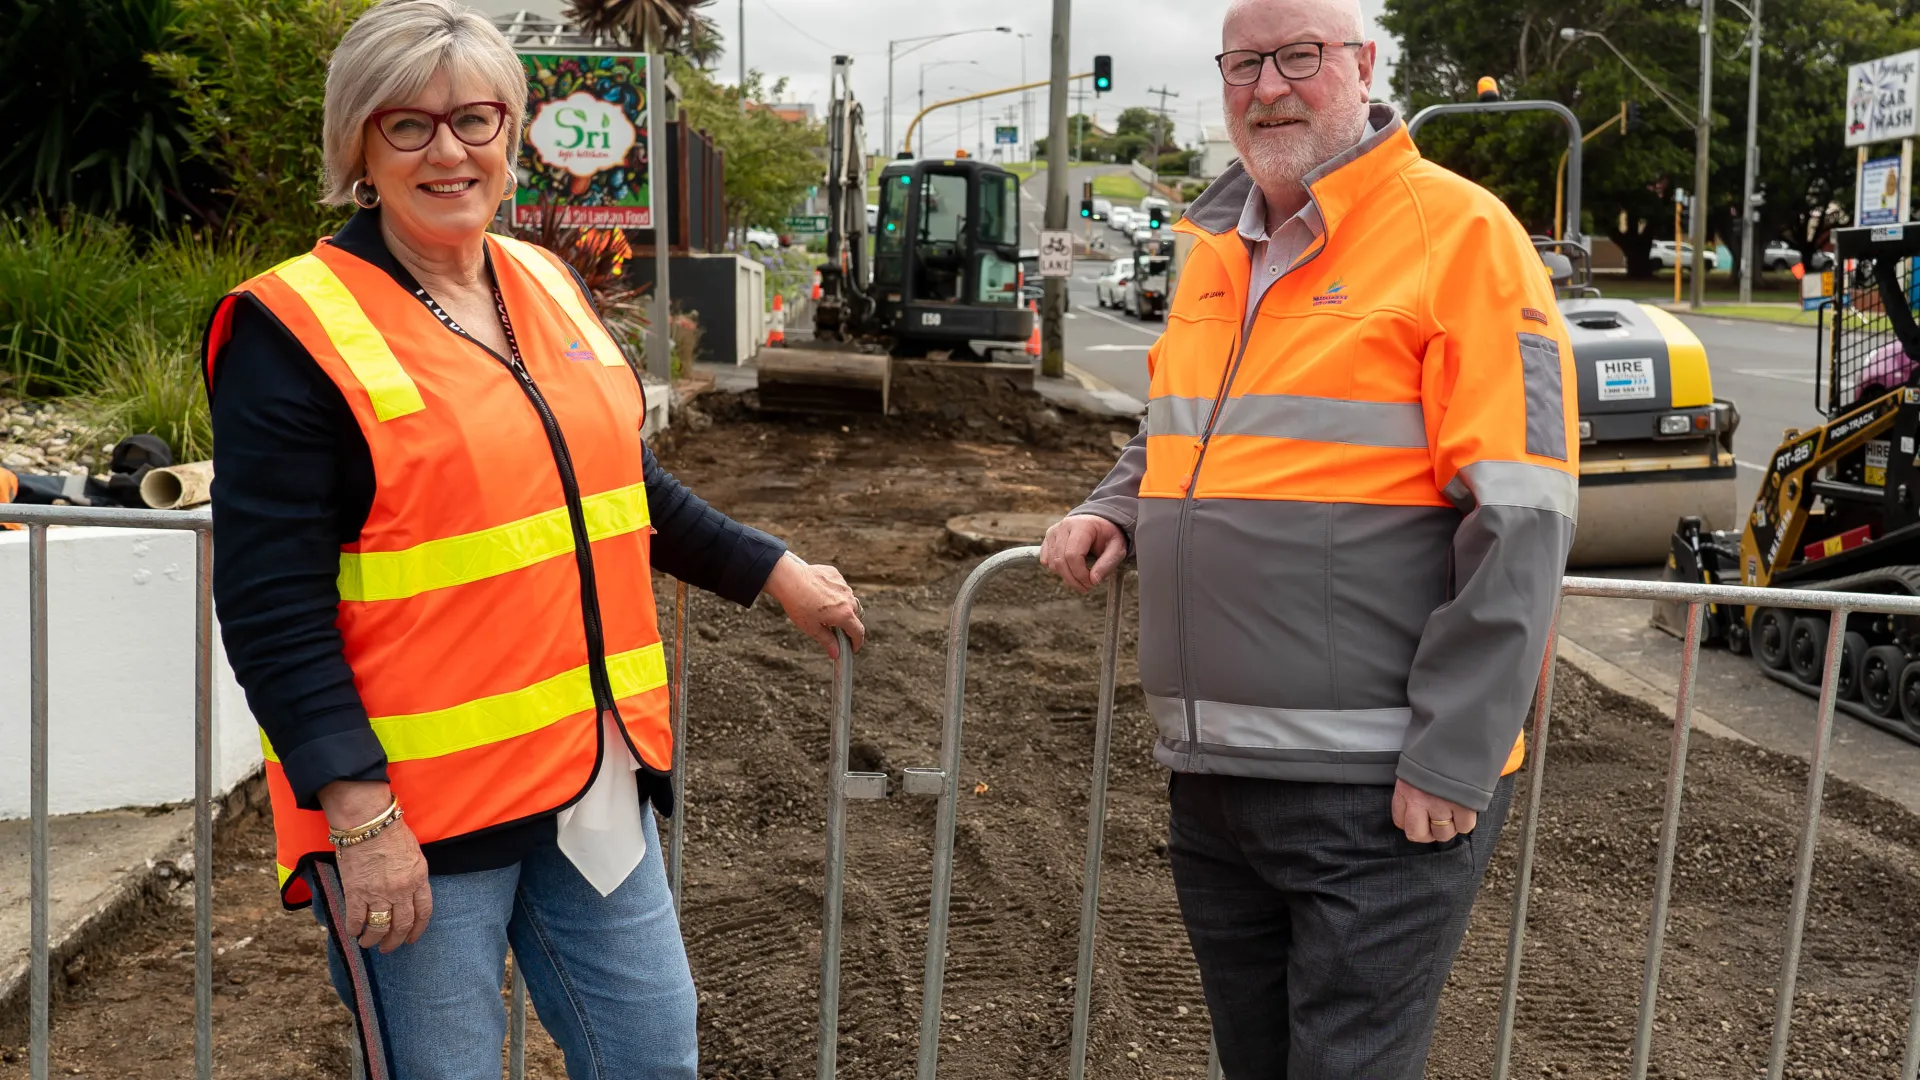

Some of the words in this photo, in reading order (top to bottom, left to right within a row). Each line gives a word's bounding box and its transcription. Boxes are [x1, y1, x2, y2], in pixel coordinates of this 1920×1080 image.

[1880, 89, 1906, 108] CAR
[554, 108, 611, 149] Sri
[1873, 108, 1912, 130] WASH
[1042, 260, 1070, 271] LANE
[1604, 361, 1643, 374] HIRE
[1776, 443, 1811, 471] RT-25
[1866, 443, 1890, 458] HIRE
